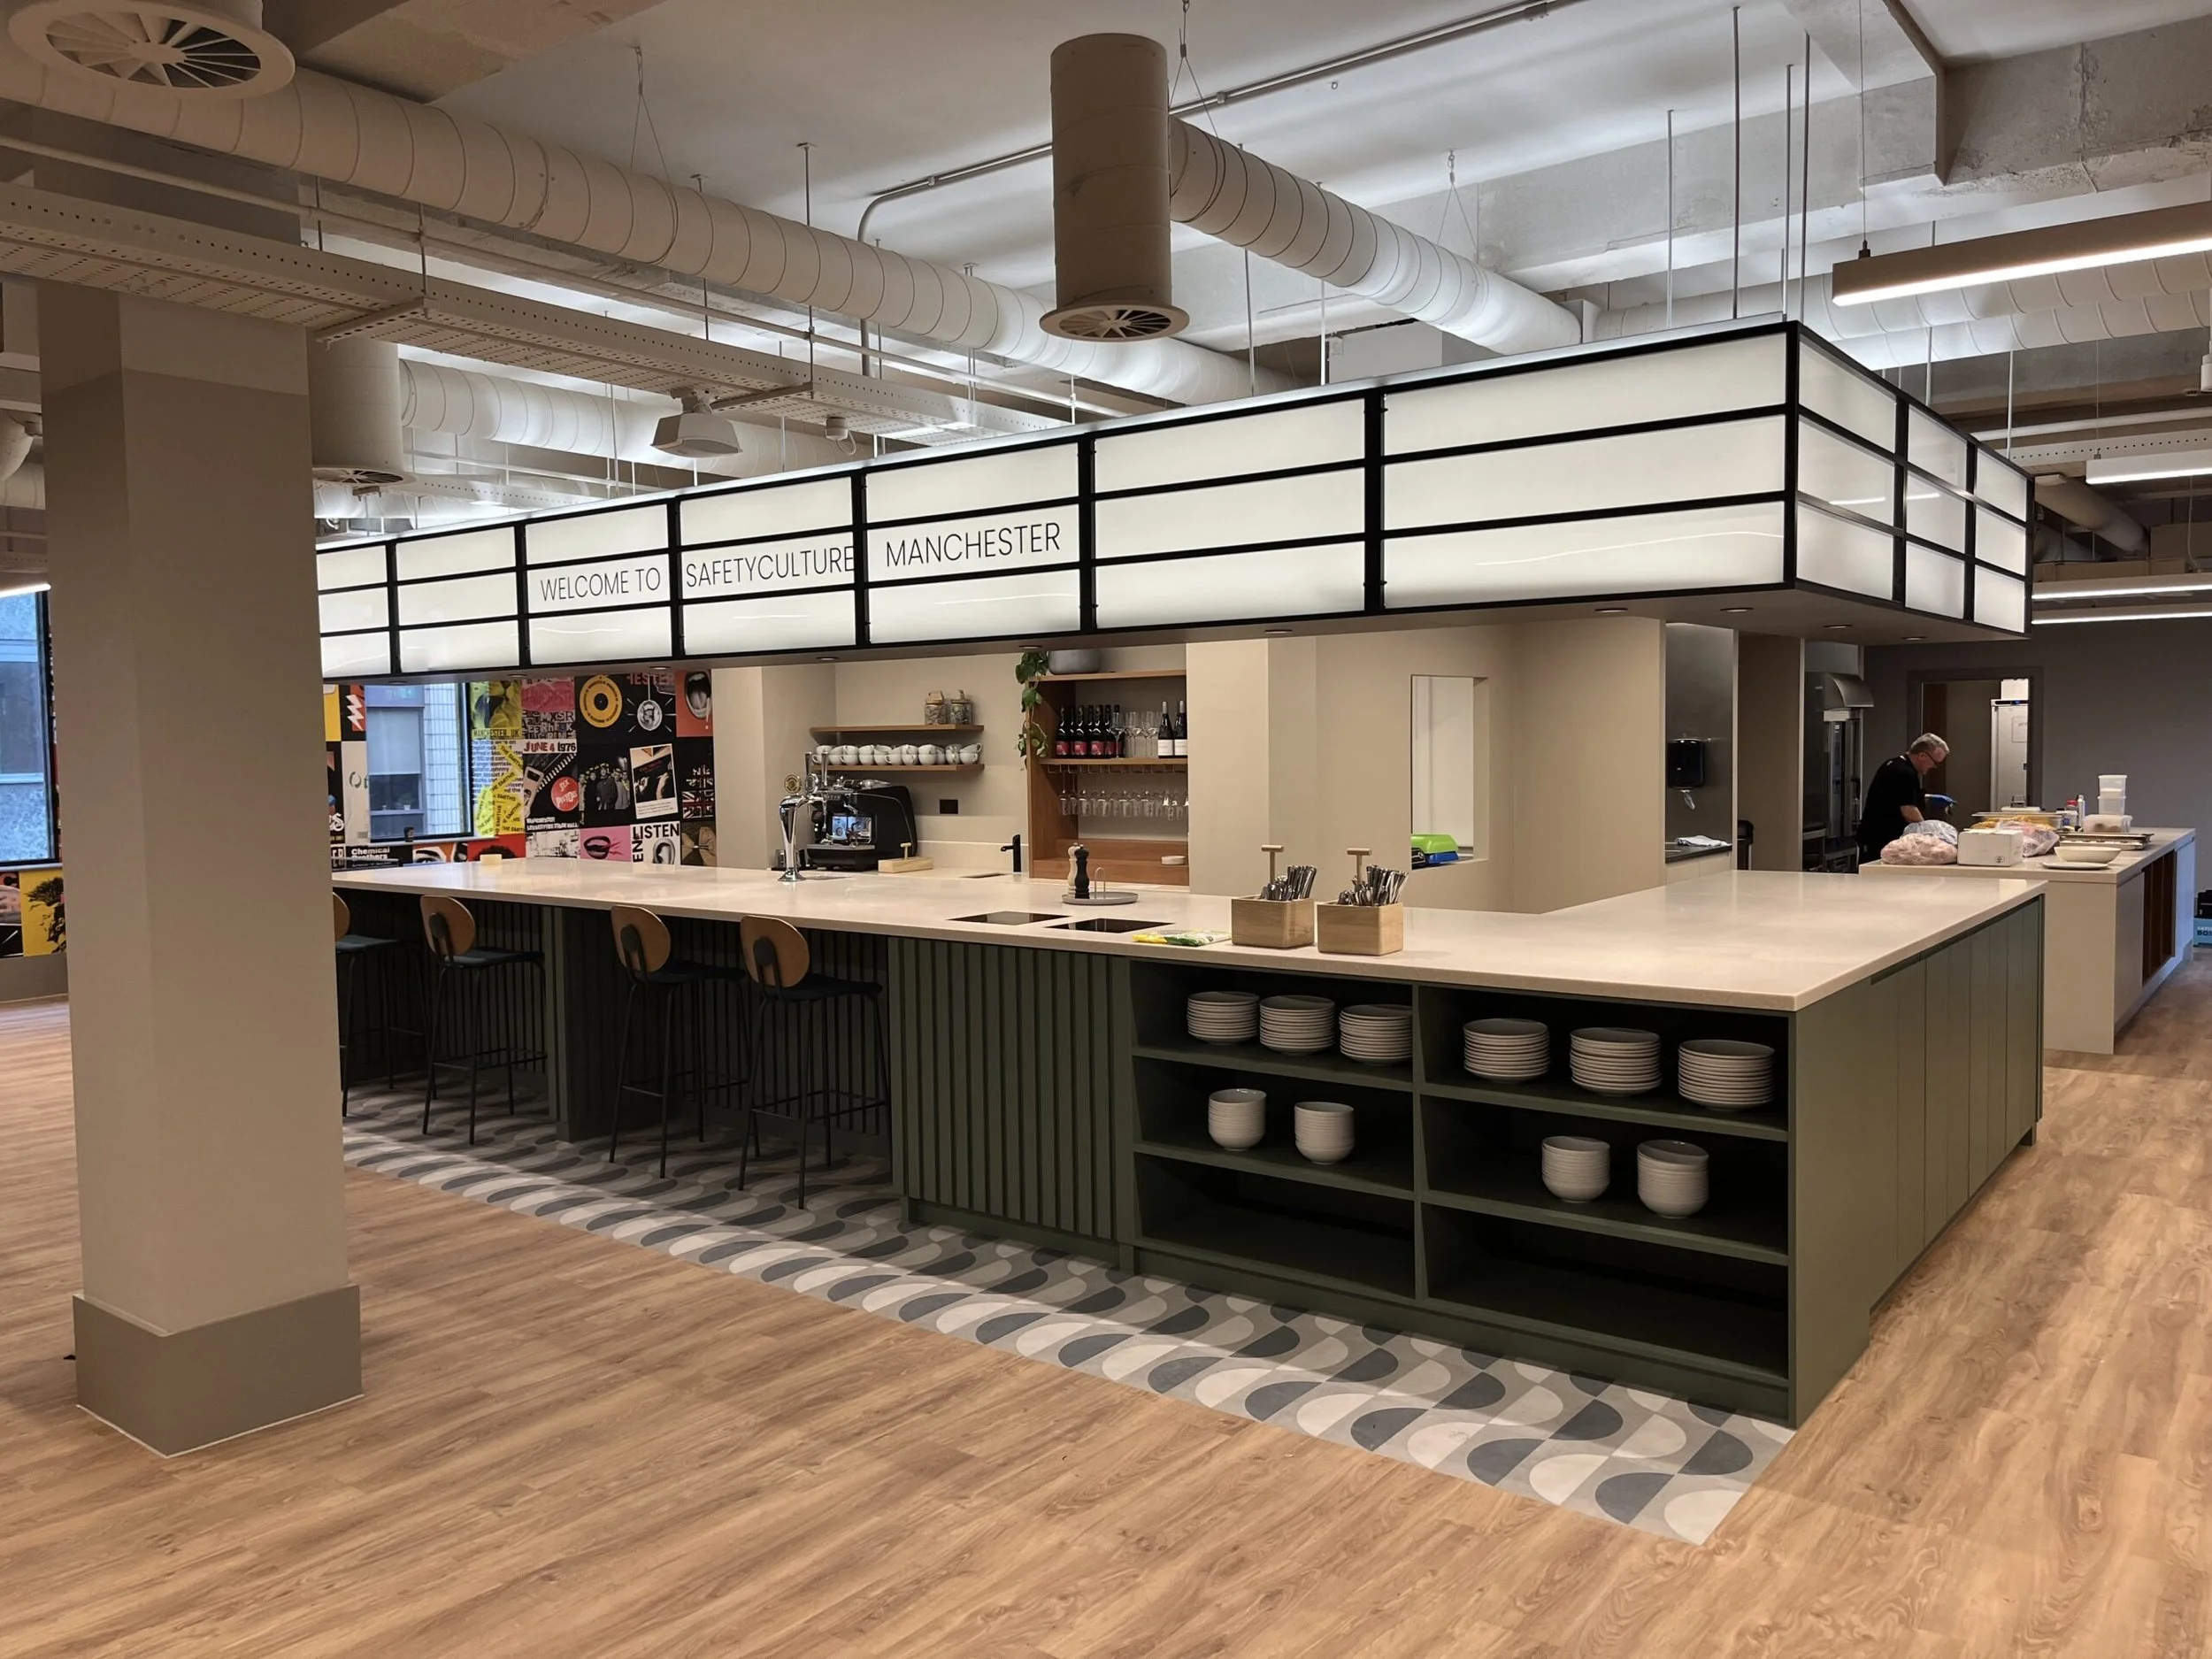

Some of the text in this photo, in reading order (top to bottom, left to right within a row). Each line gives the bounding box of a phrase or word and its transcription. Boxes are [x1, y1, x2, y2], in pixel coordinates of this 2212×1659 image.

[540, 522, 1061, 602] WELCOME TO SAFETYCULTURE MANCHESTER
[524, 741, 577, 752] JUNE 4 1976
[633, 823, 680, 840] LISTEN
[351, 846, 390, 856] Chemical
